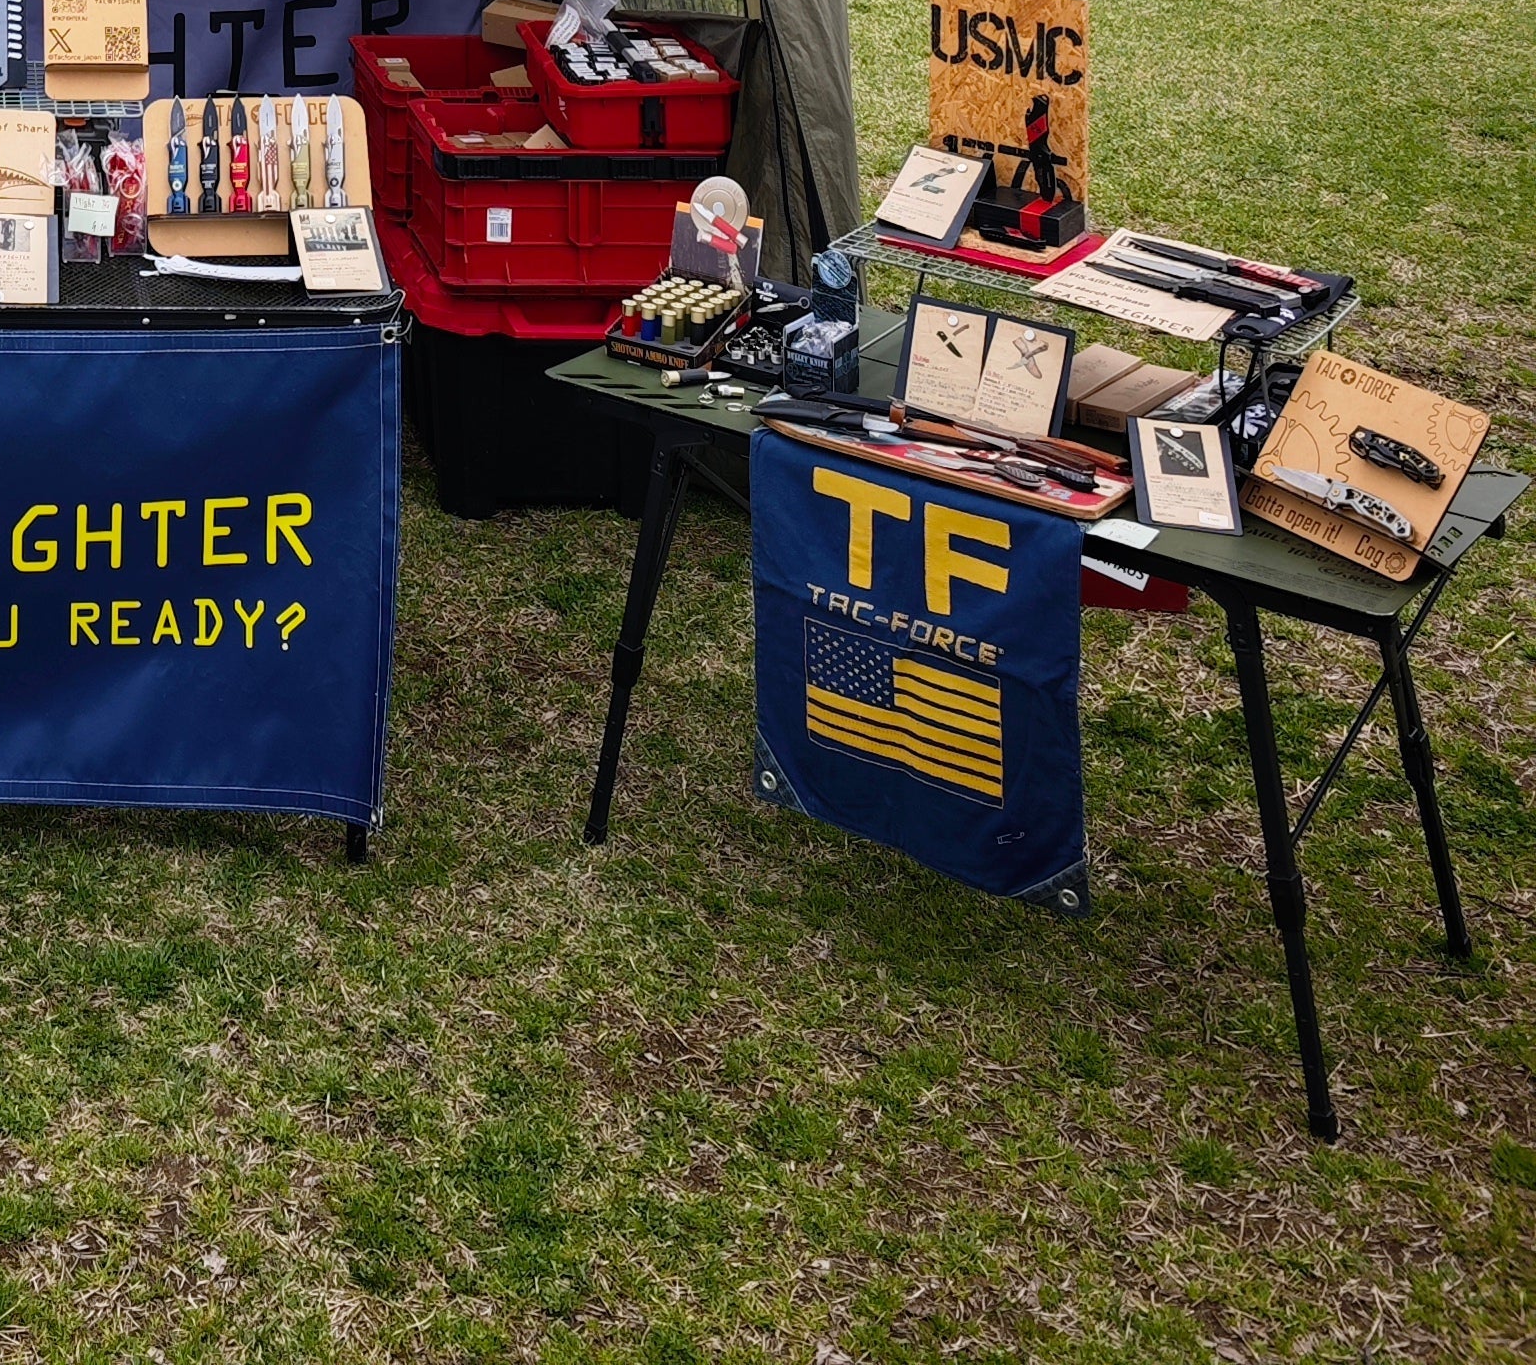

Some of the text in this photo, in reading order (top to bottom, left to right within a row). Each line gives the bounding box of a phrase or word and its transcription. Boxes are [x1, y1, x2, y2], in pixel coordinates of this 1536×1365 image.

[930, 3, 1084, 86] USMC
[16, 123, 50, 133] Shark
[275, 102, 328, 126] FOCE
[1050, 289, 1195, 334] TAC FIGHTER
[610, 341, 690, 369] SHOTGUN AMMO KNIFE
[1314, 356, 1400, 405] TAC FORCE
[812, 466, 1012, 616] TF
[1245, 484, 1283, 519] Gotta
[1285, 507, 1321, 537] open
[1321, 520, 1344, 545] it!
[1354, 533, 1385, 569] Cog
[70, 599, 307, 651] READY?
